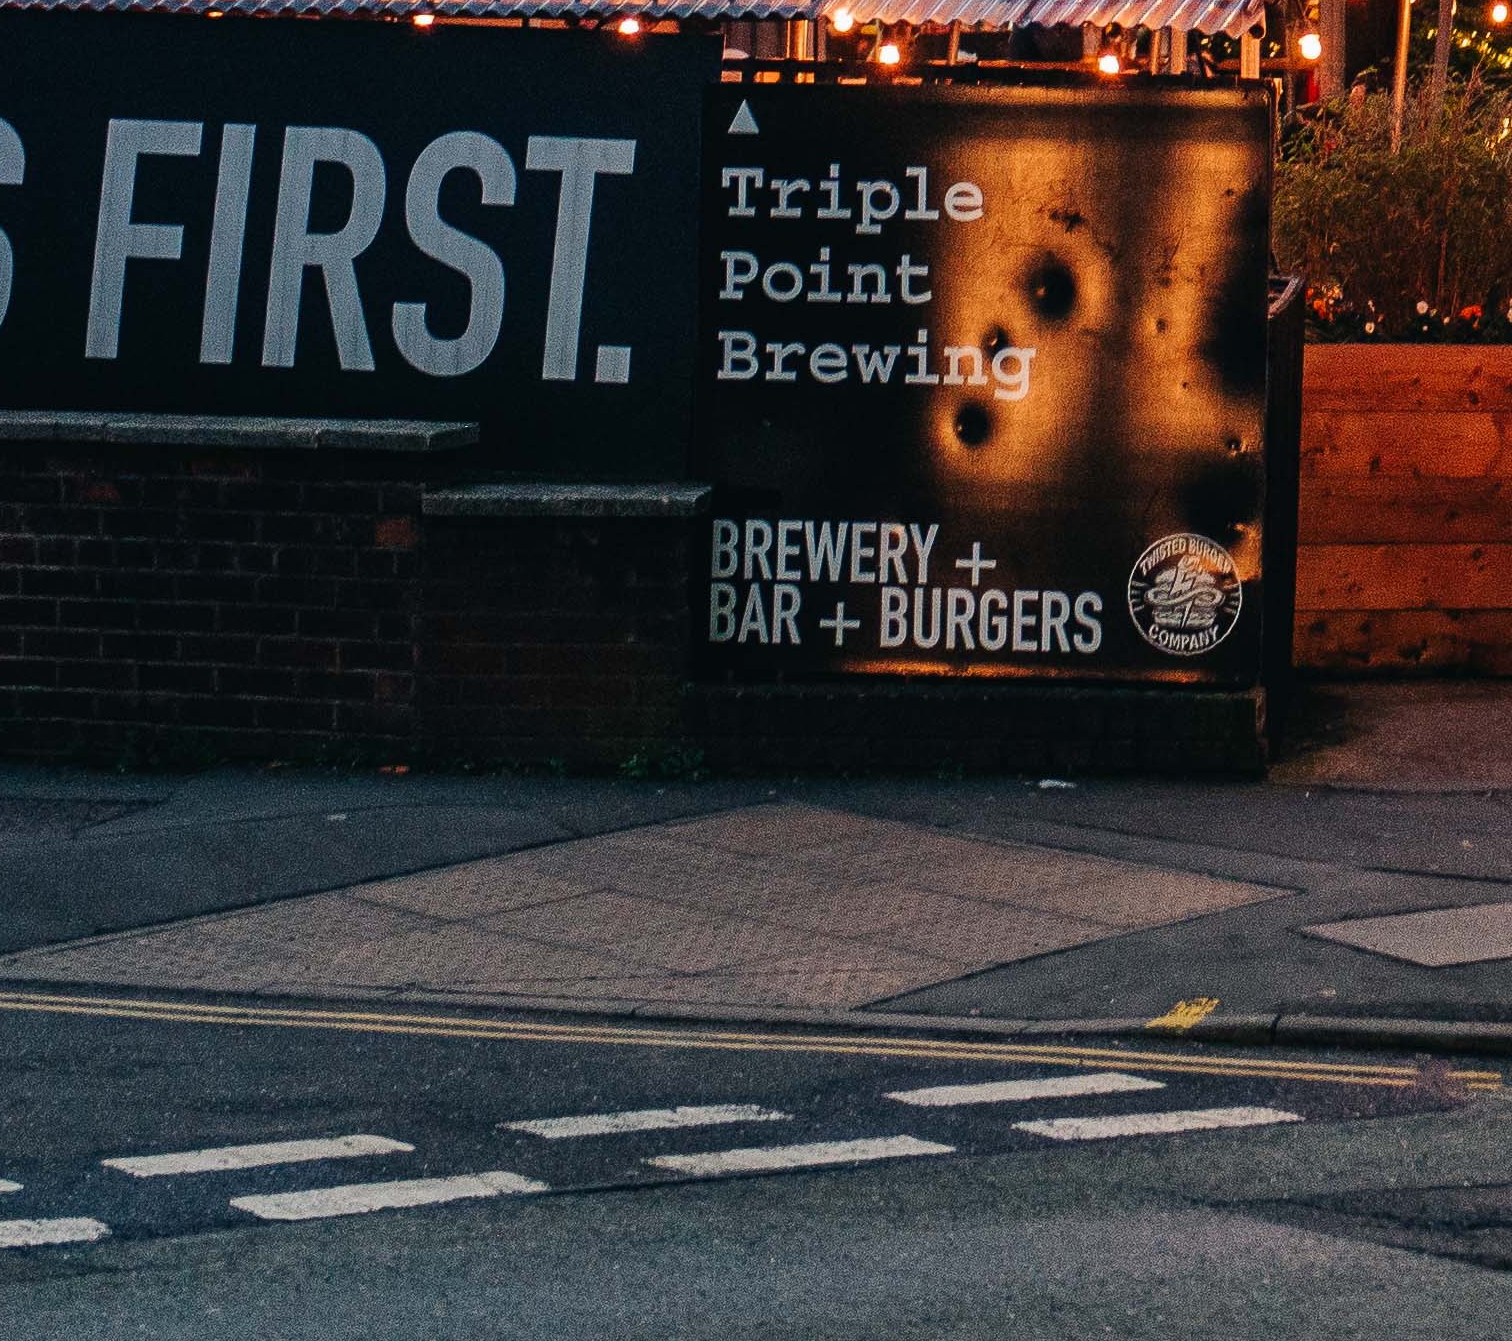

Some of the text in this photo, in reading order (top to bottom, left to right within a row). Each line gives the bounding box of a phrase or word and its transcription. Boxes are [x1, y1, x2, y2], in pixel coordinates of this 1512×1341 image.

[721, 164, 984, 235] Triple
[85, 118, 637, 384] FIRST.
[719, 247, 933, 304] Point
[717, 328, 1036, 400] Brewing
[711, 519, 940, 585] BREWERY
[709, 583, 802, 645] BAR
[879, 587, 1103, 654] BURGERS
[1148, 623, 1220, 651] COMPANY
